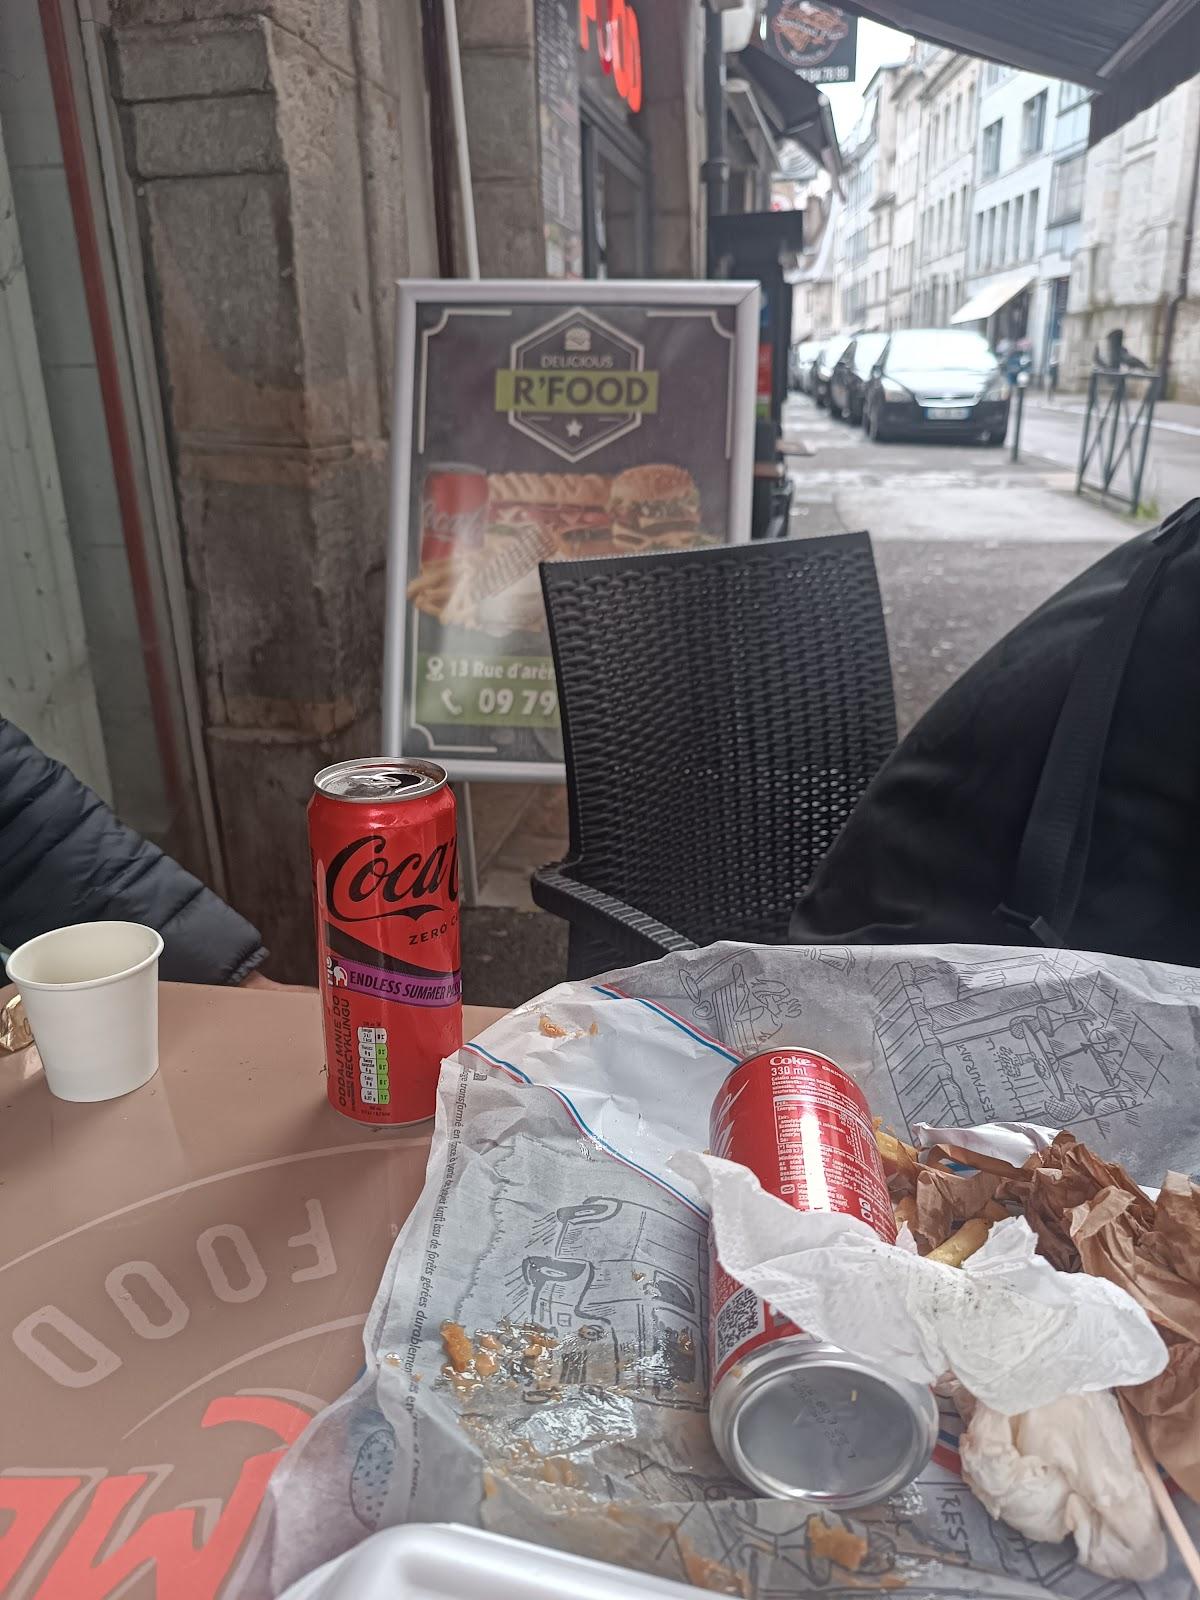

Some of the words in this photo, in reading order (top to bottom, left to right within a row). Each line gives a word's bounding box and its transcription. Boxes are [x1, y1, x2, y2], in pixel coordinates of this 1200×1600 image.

[541, 354, 614, 368] DELICIOUS
[513, 376, 649, 406] R'FOOD
[450, 660, 469, 678] 13
[472, 661, 504, 678] Rue
[479, 688, 514, 715] 09
[521, 688, 557, 716] 79
[409, 923, 447, 945] ZERO
[350, 971, 402, 995] ENDLESS
[402, 983, 446, 1000] SUMMER
[332, 996, 341, 1015] DO
[334, 1019, 344, 1056] MNIE
[341, 999, 355, 1080] RECYKLINGU
[769, 1056, 812, 1066] Coke
[771, 1067, 791, 1076] 330
[793, 1066, 807, 1076] ml
[336, 1060, 347, 1107] ODDAJ
[453, 1129, 461, 1139] en
[434, 1205, 448, 1222] kraft
[432, 1223, 444, 1238] issu
[430, 1239, 441, 1249] de
[425, 1250, 440, 1275] forêts
[12, 1198, 338, 1389] FOOD
[420, 1276, 434, 1307] gérées
